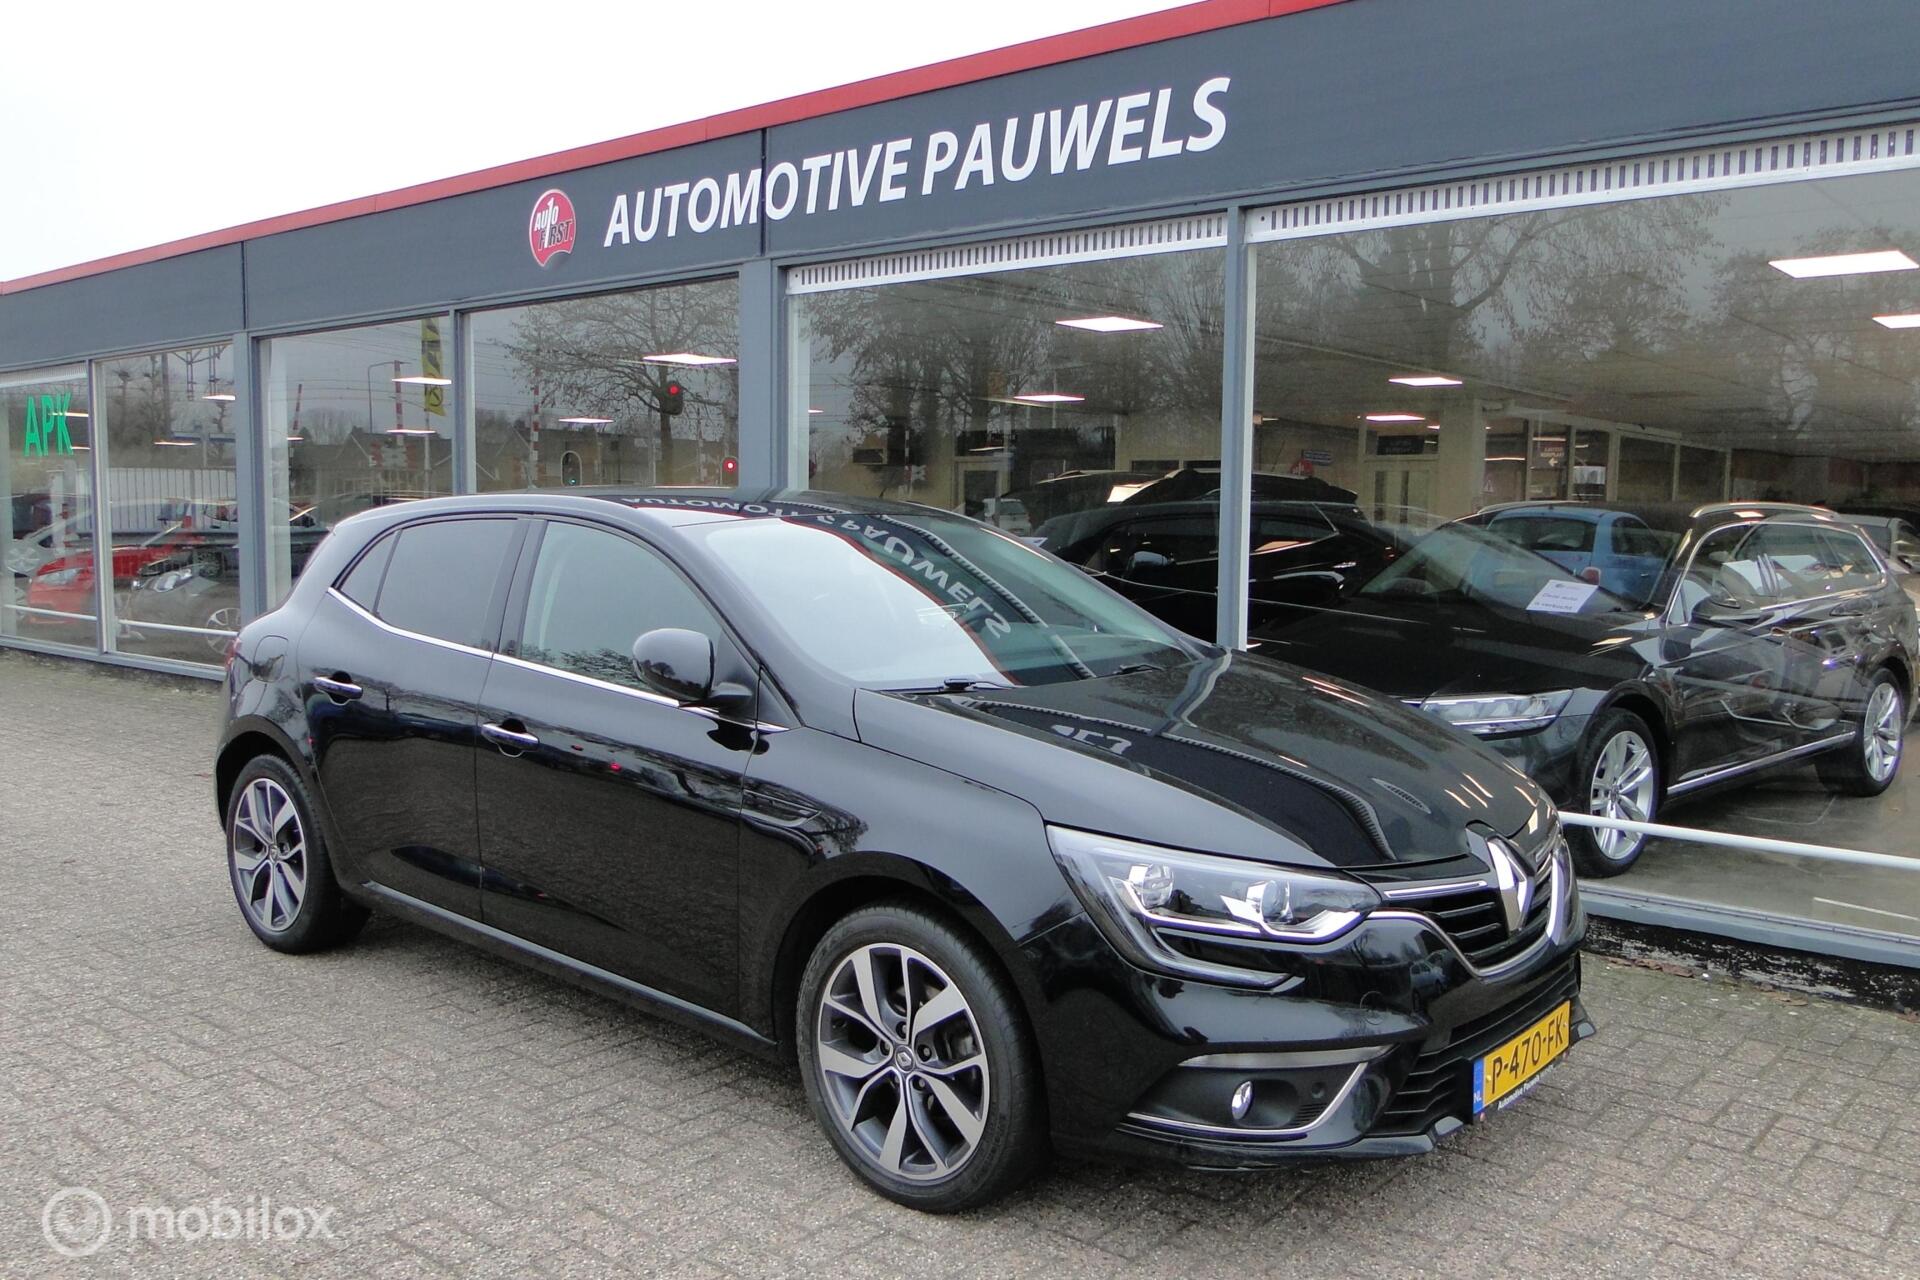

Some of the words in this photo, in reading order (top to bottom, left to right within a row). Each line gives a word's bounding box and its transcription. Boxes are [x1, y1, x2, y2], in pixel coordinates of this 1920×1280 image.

[603, 139, 913, 247] AUTOMOTIVE
[920, 76, 1231, 196] PAUWELS
[24, 392, 74, 456] APK
[1491, 1012, 1563, 1095] P-470-FK
